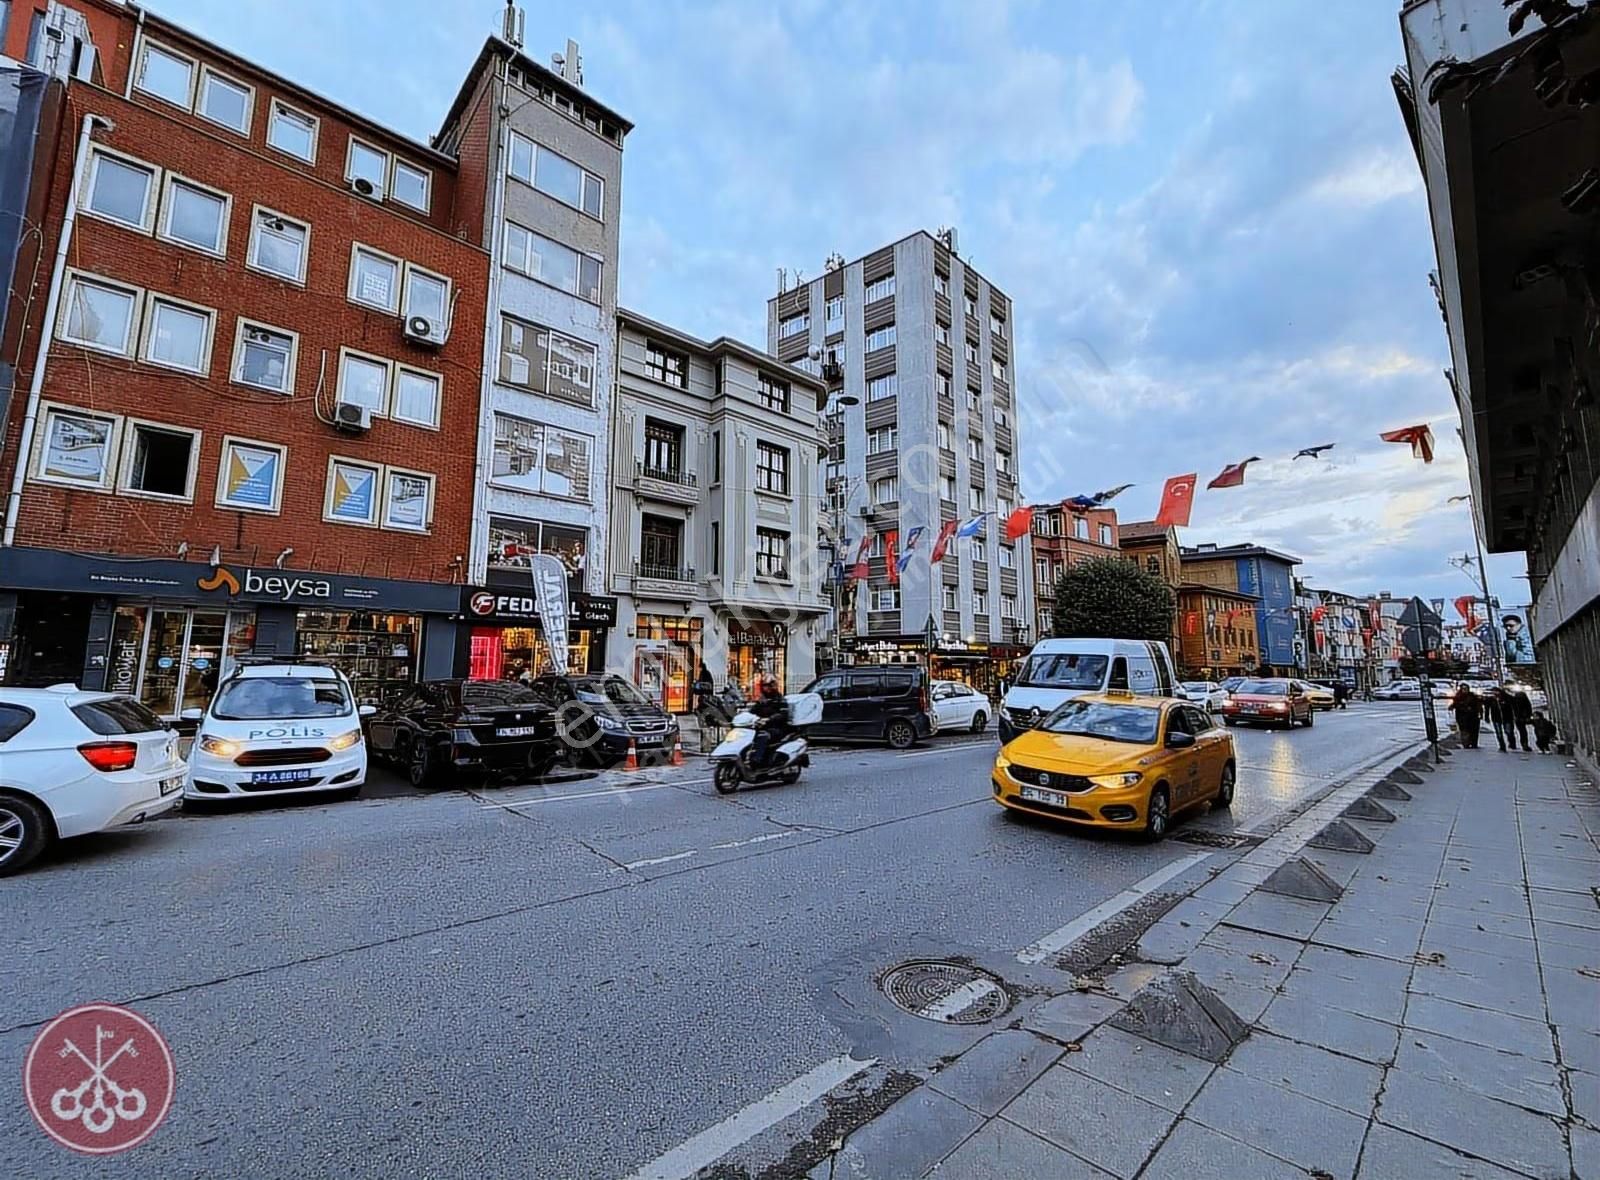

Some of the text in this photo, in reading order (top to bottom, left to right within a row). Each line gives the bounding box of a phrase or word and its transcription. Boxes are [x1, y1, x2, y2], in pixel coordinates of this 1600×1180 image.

[244, 568, 330, 601] beysa
[497, 595, 581, 616] FEDL
[249, 726, 325, 740] POLİS
